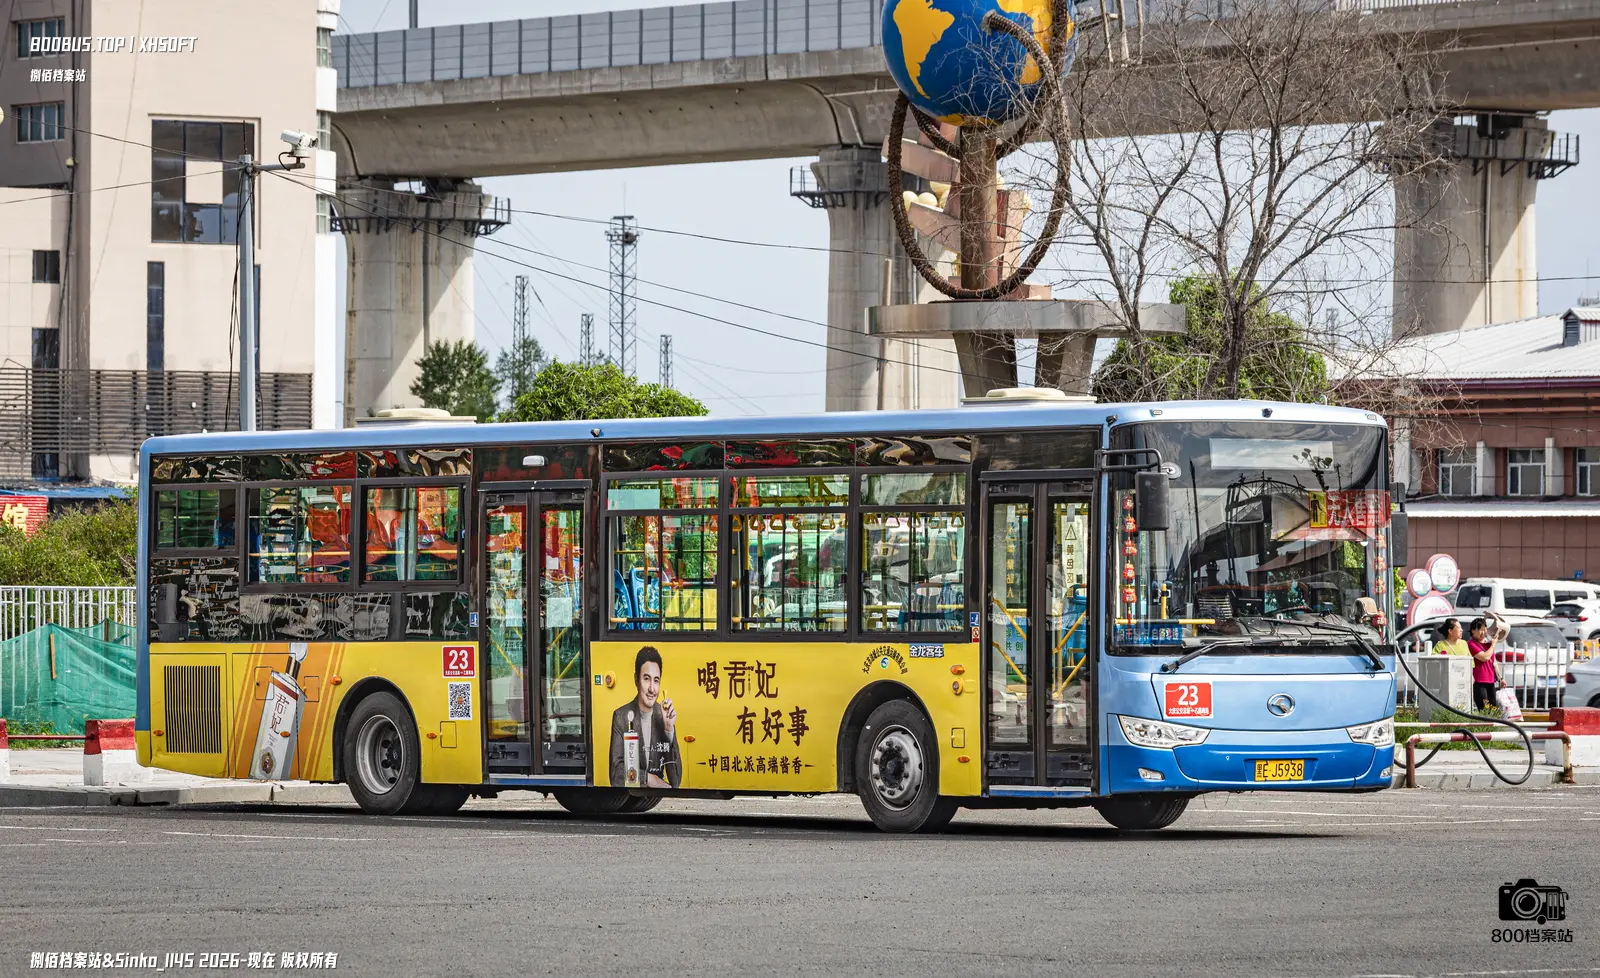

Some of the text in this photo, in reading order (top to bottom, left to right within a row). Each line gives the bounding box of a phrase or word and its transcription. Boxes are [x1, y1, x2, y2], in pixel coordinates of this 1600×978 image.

[449, 649, 468, 669] 23
[909, 645, 944, 657] 金龙客车
[697, 660, 778, 699] 喝君妃
[1178, 685, 1199, 706] 23
[735, 706, 810, 746] 有好事
